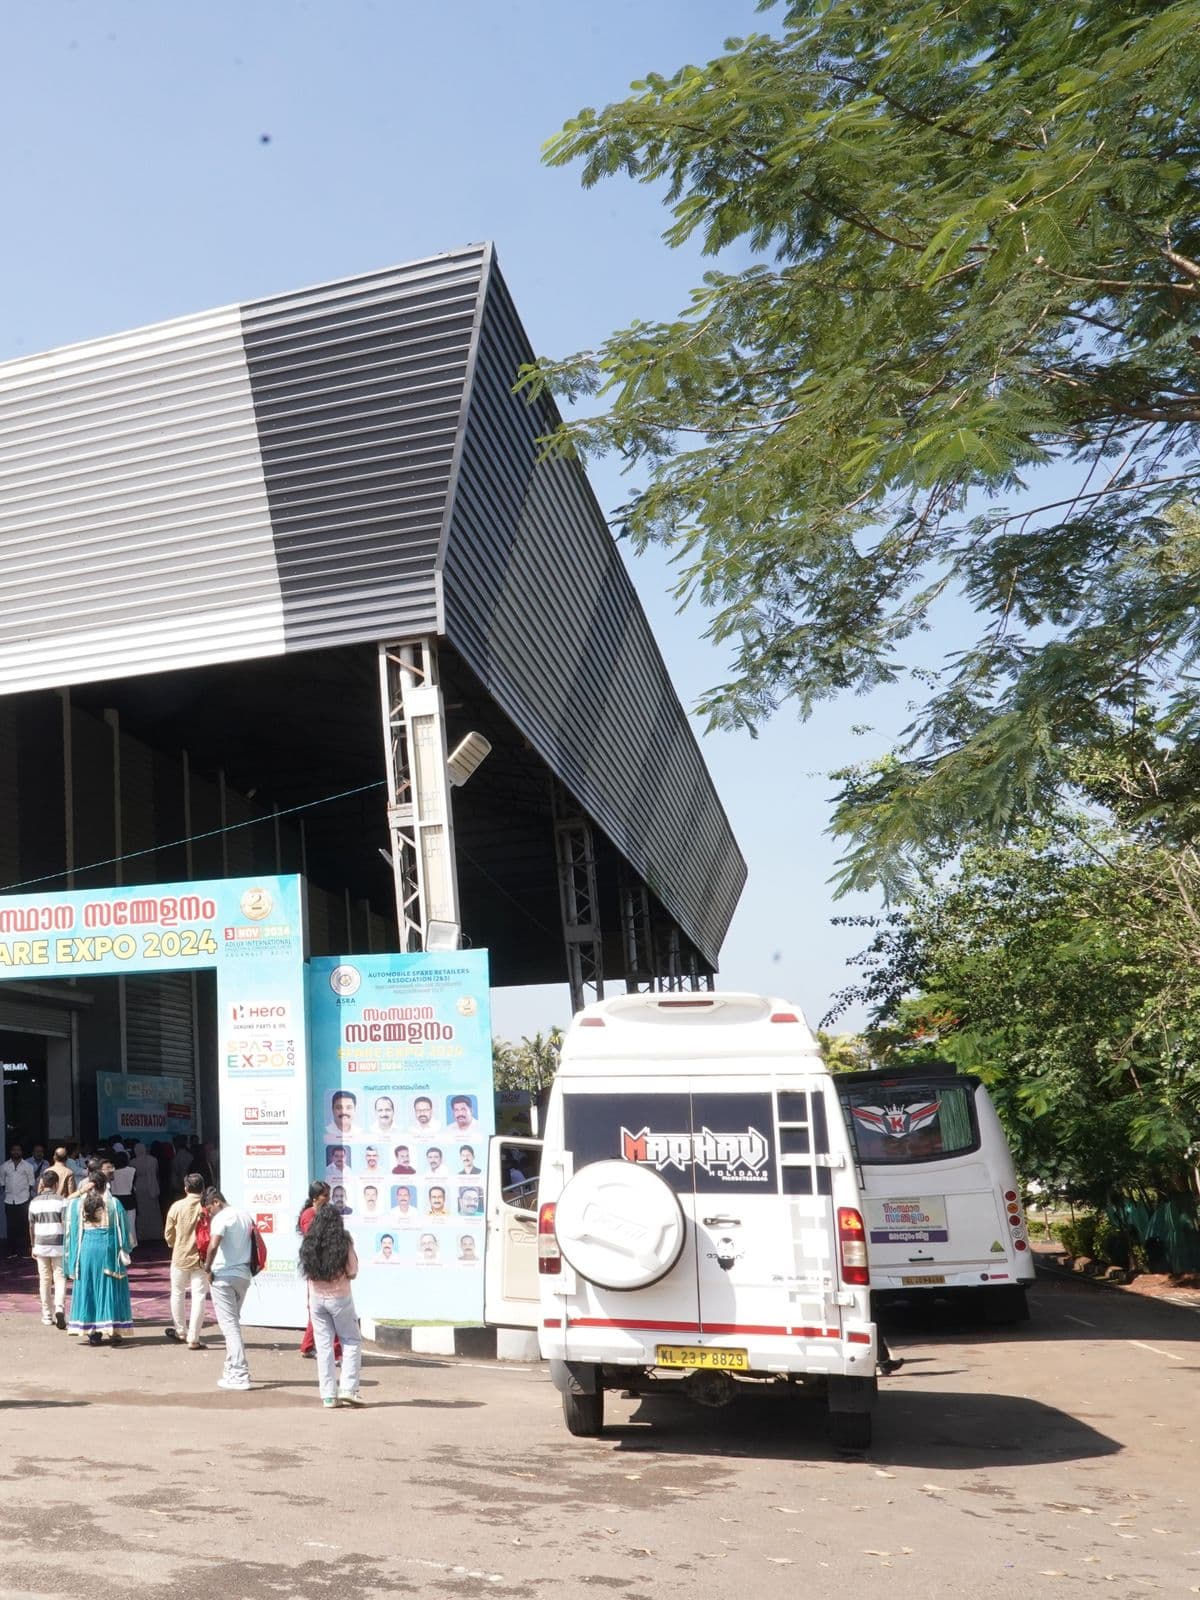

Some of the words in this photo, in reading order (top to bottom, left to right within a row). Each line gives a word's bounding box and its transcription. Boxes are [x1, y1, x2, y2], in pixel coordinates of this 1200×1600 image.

[84, 896, 216, 927] സമ്മേളനം
[55, 934, 137, 963] EXPO
[143, 929, 218, 958] 2024
[368, 970, 411, 978] AUTOMOBILE
[412, 969, 433, 977] SPARE
[249, 1006, 286, 1017] Hero
[345, 1022, 453, 1044] സമ്മേളനം
[227, 1040, 286, 1052] SPARE
[286, 1039, 295, 1067] 2024
[227, 1054, 285, 1068] EXPO
[120, 1111, 168, 1129] REGISTRATION
[260, 1109, 286, 1118] Smart
[660, 1350, 677, 1364] KL
[680, 1351, 696, 1365] 23
[700, 1352, 708, 1366] P
[711, 1352, 744, 1367] 8829
